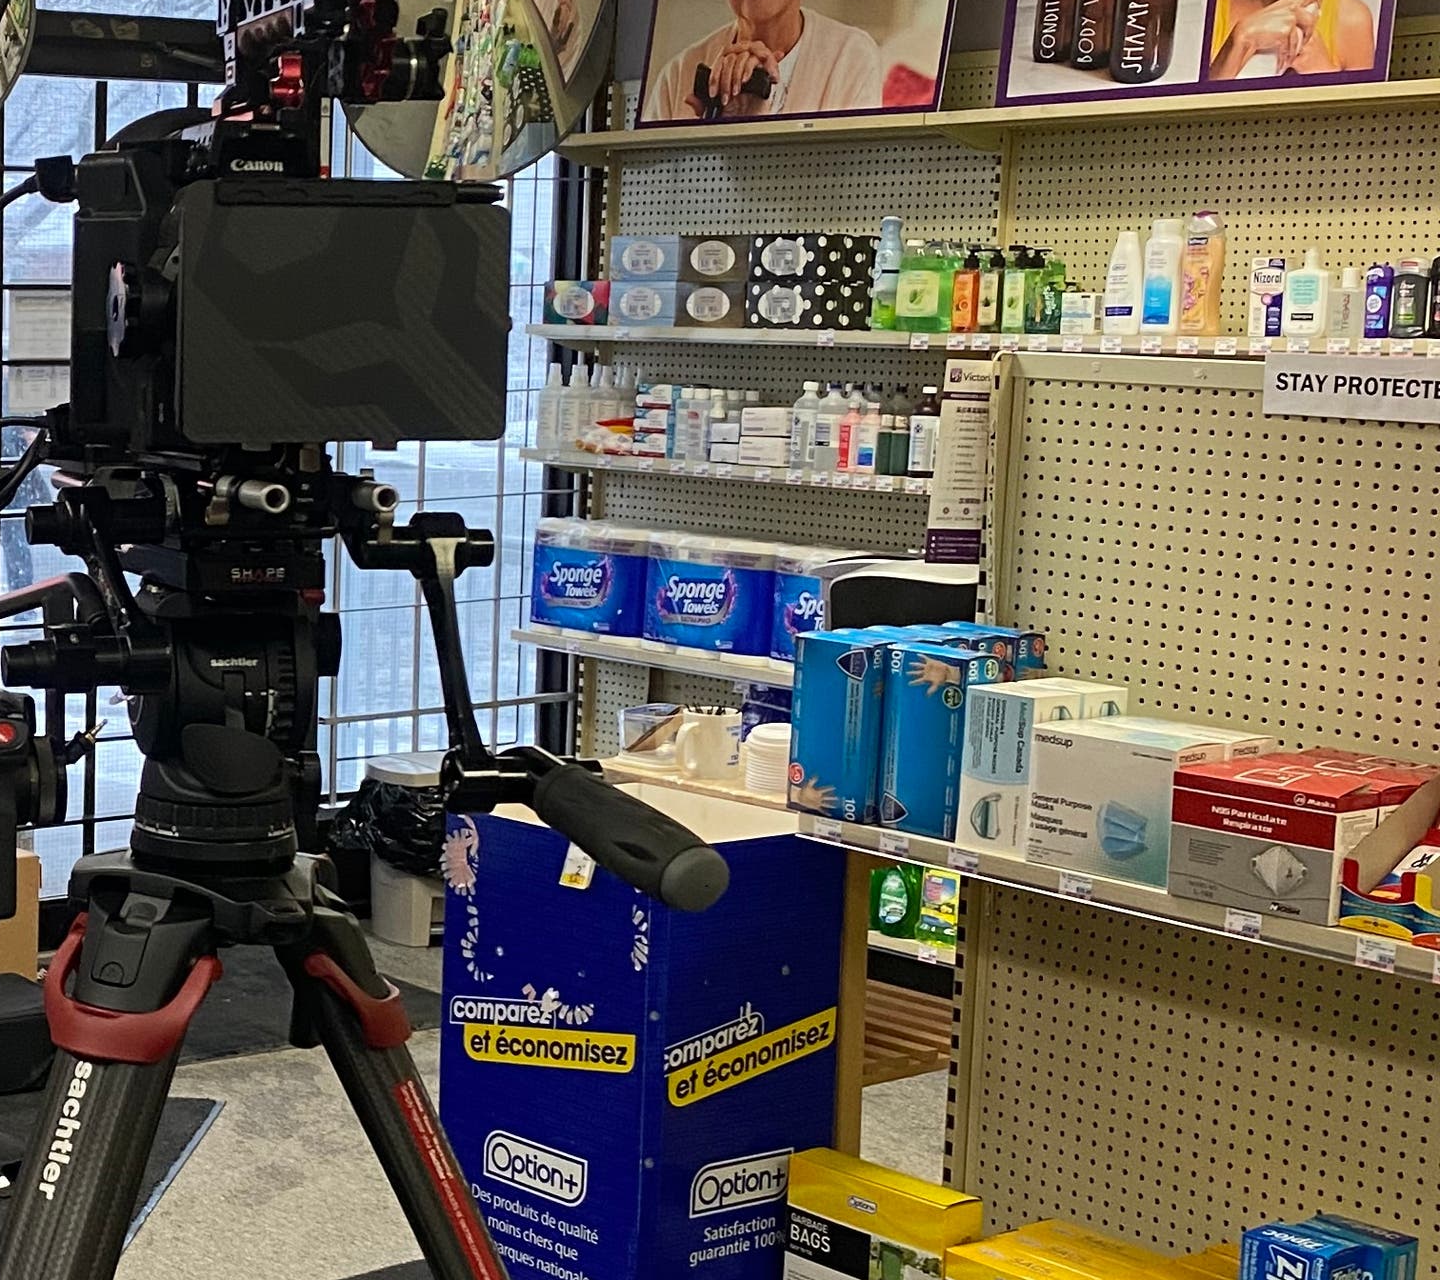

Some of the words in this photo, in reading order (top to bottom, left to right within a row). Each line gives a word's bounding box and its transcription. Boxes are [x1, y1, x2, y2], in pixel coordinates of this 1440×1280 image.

[1077, 12, 1096, 64] BODY
[230, 159, 284, 173] Canon
[1253, 271, 1283, 284] Nizoral
[1275, 372, 1329, 393] STAY
[549, 561, 603, 587] Sponge
[565, 583, 598, 597] Towels
[667, 575, 726, 603] Sponge
[682, 599, 720, 615] Towels
[210, 657, 258, 667] sachtler
[891, 650, 902, 674] 100
[968, 660, 978, 682] 100
[1034, 733, 1073, 749] medsup
[1015, 740, 1026, 774] Canada
[844, 797, 856, 821] 100
[1031, 792, 1059, 805] General
[1060, 797, 1093, 811] Purpose
[1031, 800, 1054, 812] Masks
[1035, 822, 1058, 835] usage
[1222, 817, 1273, 834] Respirator
[1231, 808, 1287, 826] Particulate
[453, 1000, 552, 1025] comparez
[470, 1030, 491, 1053] et
[495, 1029, 627, 1066] économisez
[675, 1069, 698, 1099] et
[703, 1021, 830, 1088] économisez
[38, 1060, 93, 1201] sachtler
[491, 1142, 578, 1193] Option+
[698, 1167, 785, 1206] Option+
[471, 1183, 492, 1203] Des
[493, 1195, 539, 1222] produits
[540, 1211, 556, 1229] de
[558, 1221, 599, 1245] qualité
[790, 1212, 828, 1234] GARBAGE
[488, 1216, 522, 1239] moins
[523, 1228, 553, 1251] chers
[554, 1242, 578, 1261] que
[703, 1216, 776, 1243] Satisfaction
[789, 1223, 831, 1253] BAGS
[1261, 1229, 1323, 1250] Ziploc
[689, 1237, 750, 1267] guarantie
